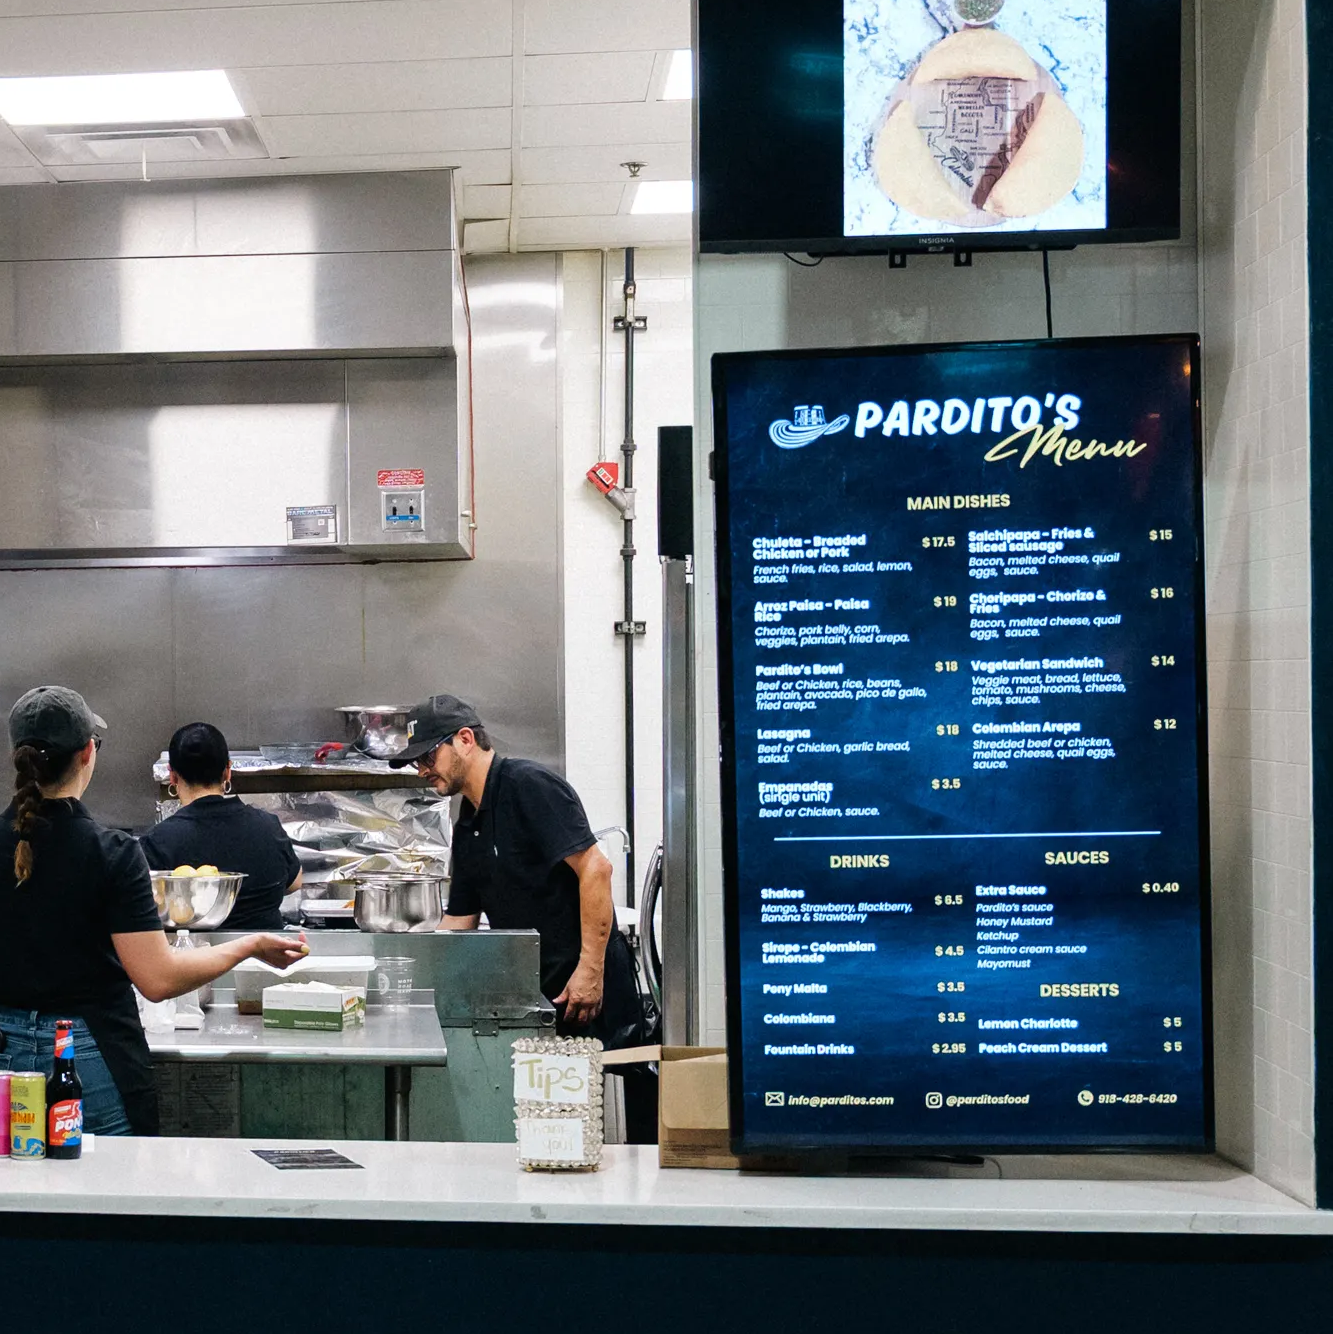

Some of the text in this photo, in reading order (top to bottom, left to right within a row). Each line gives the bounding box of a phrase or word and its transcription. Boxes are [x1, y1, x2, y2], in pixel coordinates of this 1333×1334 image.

[854, 393, 1082, 438] PARDITO'S
[984, 423, 1148, 469] Menu
[907, 493, 1010, 511] MAIN DISHES
[968, 529, 1040, 544] Salchipapa
[1052, 527, 1082, 539] Fries
[1084, 527, 1094, 538] &
[752, 546, 849, 560] Chicken or Pork
[968, 541, 1063, 555] Sliced sausage
[752, 561, 913, 575] French fries, rice, salad, lemon,
[970, 602, 1000, 614] Fries
[754, 610, 782, 622] Rice
[754, 624, 880, 638] Chorizo, pork belly, corn,
[756, 663, 843, 676] Pardito's Bowl
[970, 657, 1104, 674] Vegetarian Sandwich
[971, 672, 1122, 688] Veggie meat, bread, lettuce,
[757, 727, 811, 742] Lasagna
[972, 721, 1081, 735] Colombian Arepa
[758, 780, 833, 795] Empanadas
[760, 790, 830, 805] (single unit)
[830, 853, 889, 868] DRINKS
[1044, 850, 1109, 865] SAUCES
[760, 887, 805, 899] Shakes
[976, 884, 1046, 896] Extra Sauce
[761, 901, 912, 915] Mango, Strawberry, Blackberry,
[975, 902, 1053, 913] Pardito's sauce
[761, 911, 866, 924] Banana & Strawberry
[975, 915, 1053, 929] Honey Mustard
[976, 930, 1019, 943] Ketchup
[976, 944, 1086, 954] Cilantro cream sauce
[762, 952, 825, 964] Lemonade
[762, 982, 828, 996] Pony Malta
[1040, 983, 1119, 997] DESSERTS
[763, 1012, 836, 1024] Colombiana
[978, 1017, 1078, 1029] Lemon Charlotte
[764, 1043, 855, 1055] Fountain Drinks
[978, 1041, 1108, 1053] Peach Cream Dessert
[519, 1058, 584, 1100] Tips
[787, 1095, 894, 1108] info@parditos.com
[945, 1094, 1029, 1108] @parditosfood
